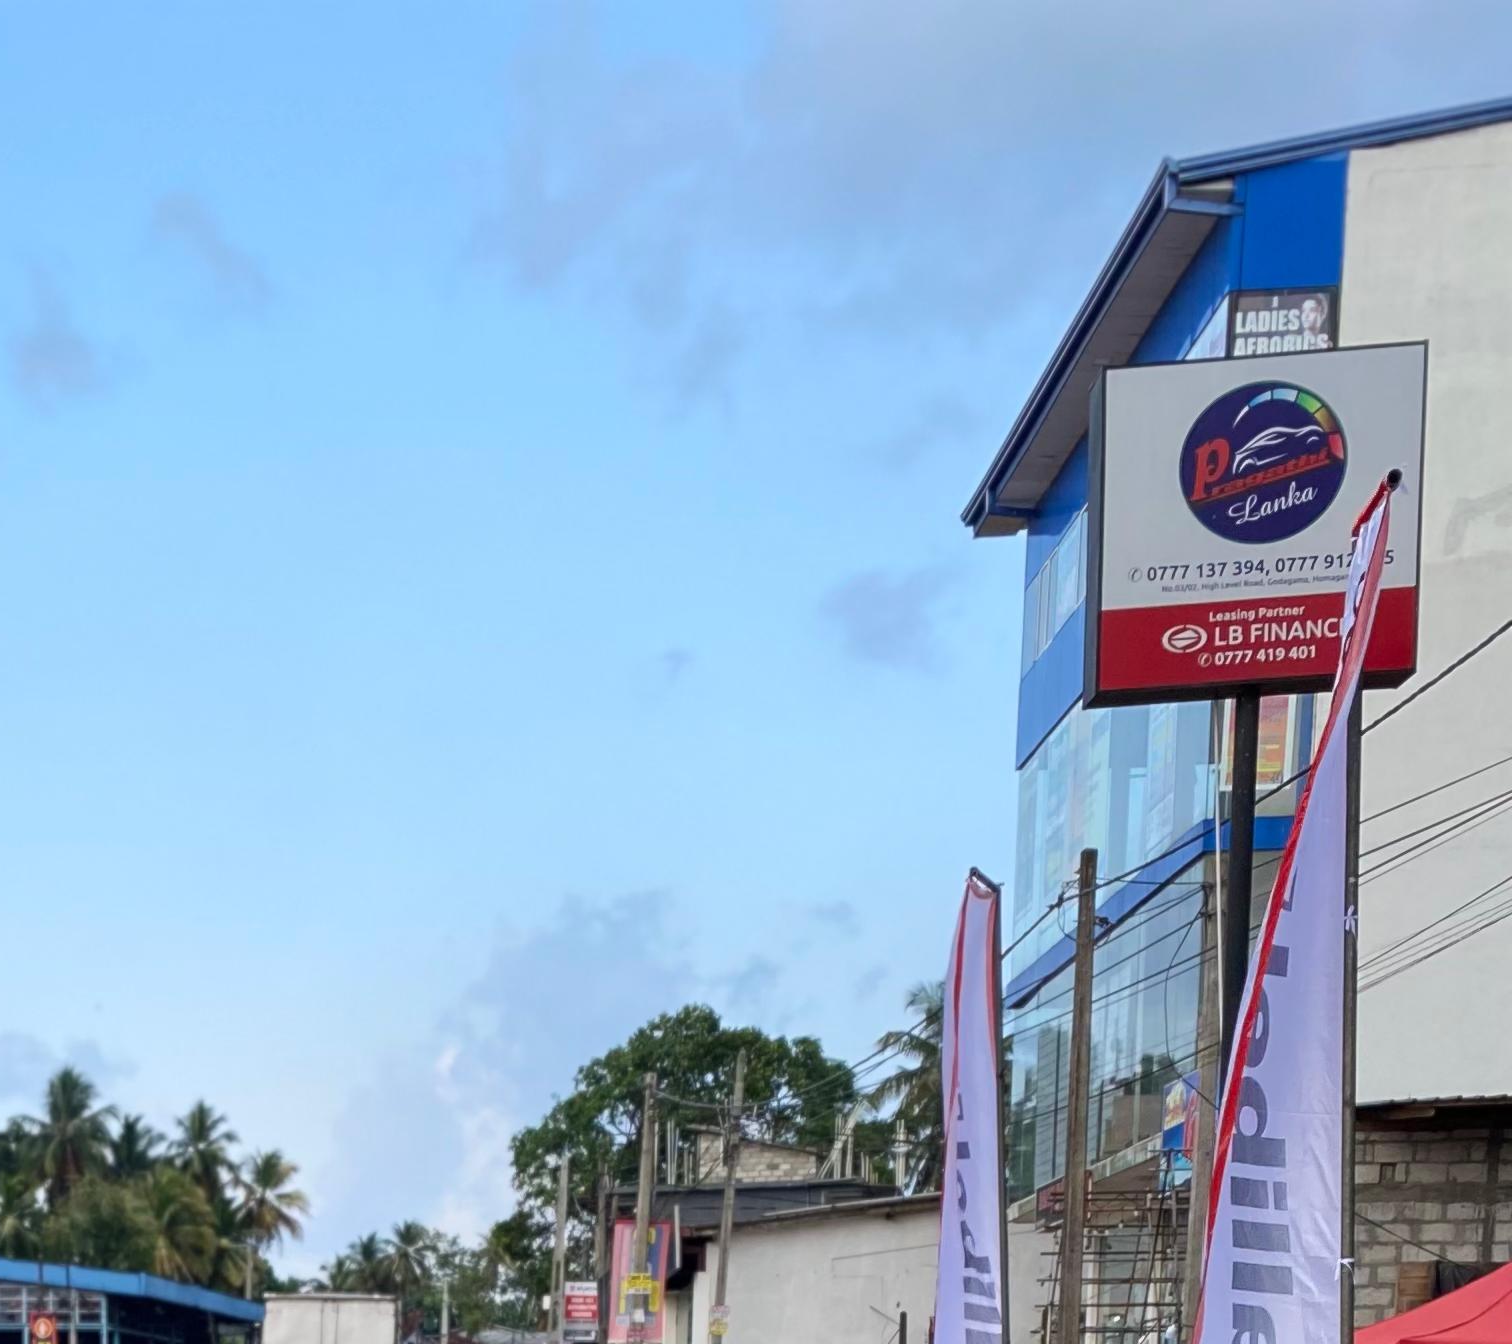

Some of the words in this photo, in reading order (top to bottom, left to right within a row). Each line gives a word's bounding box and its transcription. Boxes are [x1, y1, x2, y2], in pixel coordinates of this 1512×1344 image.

[1235, 308, 1301, 334] LADIES
[1228, 480, 1319, 525] Lanka
[1146, 564, 1190, 582] 0777
[1196, 562, 1228, 579] 137
[1232, 559, 1271, 577] 394,
[1275, 555, 1318, 573] 0777
[1209, 608, 1255, 622] Leasing
[1258, 605, 1305, 619] Partner
[1214, 624, 1243, 646] LB
[1214, 651, 1252, 666] 0777
[1256, 648, 1285, 662] 419
[1288, 645, 1316, 659] 401
